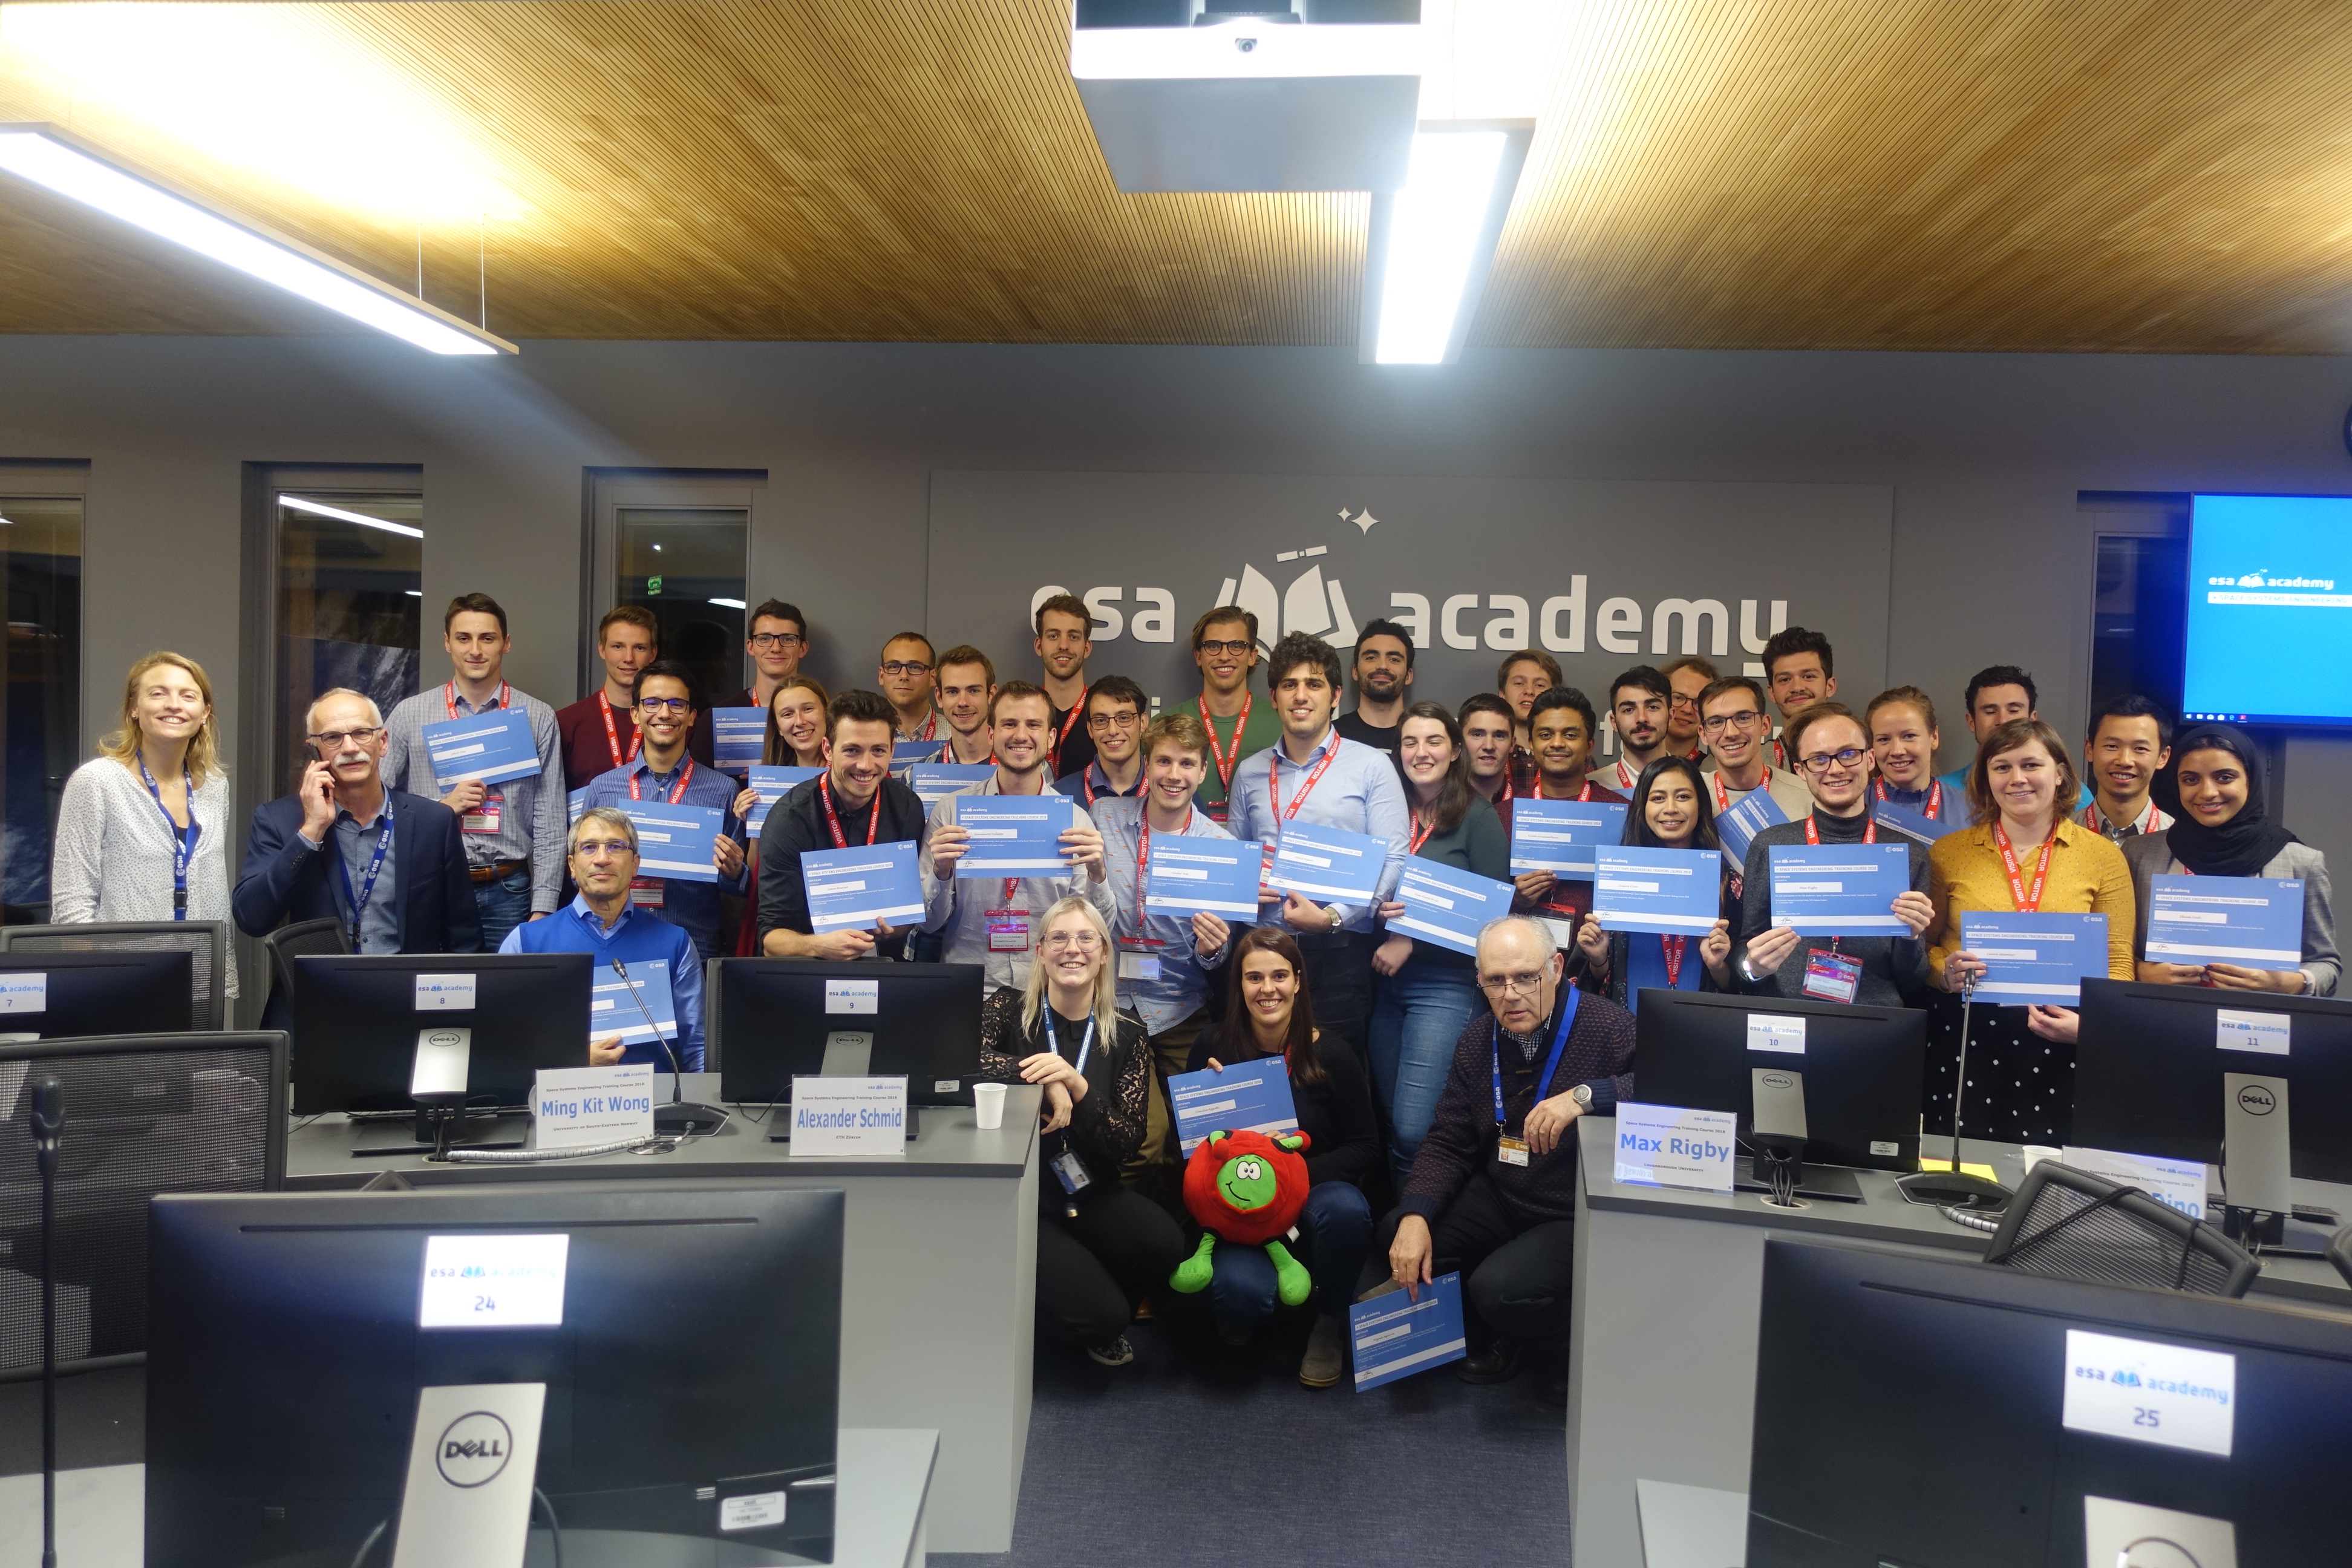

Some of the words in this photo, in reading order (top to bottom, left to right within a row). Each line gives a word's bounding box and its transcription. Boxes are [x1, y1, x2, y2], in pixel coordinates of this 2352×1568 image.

[2209, 577, 2235, 586] esa
[2267, 577, 2334, 590] academy
[1388, 575, 1788, 677] academy
[599, 691, 608, 709] VISITOR
[1076, 693, 1086, 710] VISITOR
[605, 713, 613, 733] VISITOR
[1065, 713, 1077, 730] VISITOR
[1205, 718, 1214, 737] VISITOR
[1236, 716, 1245, 734] VISITOR
[630, 738, 639, 757] VISITOR
[1212, 740, 1222, 760] VISITOR
[1229, 739, 1238, 758] VISITOR
[684, 763, 694, 781] VISITOR
[1311, 760, 1328, 780] VISITOR
[1617, 765, 1627, 783] VISITOR
[671, 784, 685, 804] VISITOR
[1138, 779, 1149, 797] VISITOR
[1294, 783, 1312, 804] VISITOR
[1580, 784, 1590, 802] VISITOR
[1931, 784, 1939, 806] VISITOR
[822, 789, 832, 814] VISITOR
[2149, 809, 2158, 830] VISITOR
[831, 820, 841, 844] VISITOR
[2004, 850, 2016, 874] VISITOR
[2037, 847, 2049, 872] VISITOR
[2012, 878, 2025, 903] VISITOR
[2030, 877, 2042, 902] VISITOR
[2253, 1025, 2288, 1034] academy
[2247, 1037, 2259, 1046] 11
[542, 1100, 577, 1118] Ming
[583, 1097, 603, 1113] Kit
[609, 1096, 650, 1113] Wong
[2242, 1096, 2272, 1105] DELL
[797, 1108, 856, 1128] Alexander
[860, 1108, 901, 1127] Schmid
[1621, 1134, 1662, 1152] Max
[1670, 1138, 1730, 1162] Rigby
[431, 1268, 455, 1278] esa
[474, 1296, 495, 1312] 24
[2075, 1365, 2105, 1380] esa
[2148, 1377, 2229, 1405] academy
[2134, 1407, 2160, 1428] 25
[445, 1439, 503, 1460] DELL
